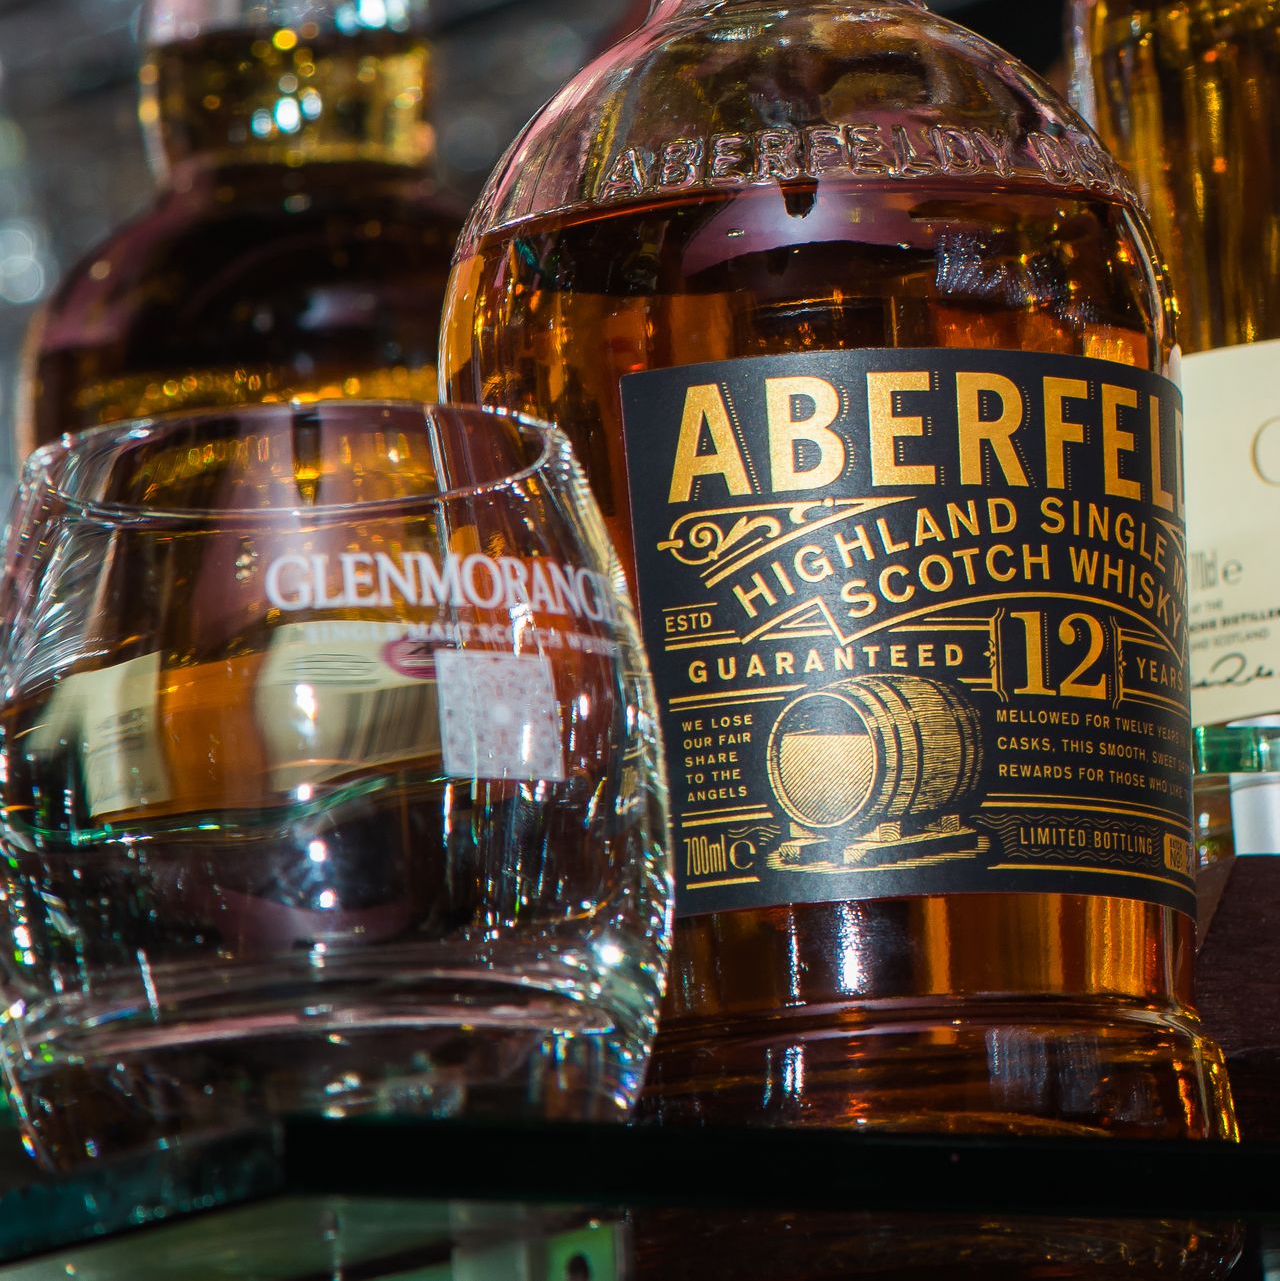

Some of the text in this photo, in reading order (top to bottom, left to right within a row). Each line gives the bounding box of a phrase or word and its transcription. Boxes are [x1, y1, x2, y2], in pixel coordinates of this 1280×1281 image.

[600, 123, 1011, 199] ABERFELDY
[732, 496, 1168, 619] HIGHLAND SINGLE
[263, 551, 621, 624] GLENMORANG
[843, 544, 1051, 619] SCOTCH
[1068, 545, 1182, 638] WHISKY
[665, 611, 712, 633] ESTD
[688, 643, 965, 684] GUARANTEED
[1009, 610, 1107, 700] 12
[1136, 656, 1184, 693] YEARS
[682, 714, 754, 732] WE LOSE
[996, 709, 1080, 725] MELLOWED
[1085, 714, 1110, 729] FOR
[1114, 716, 1154, 736] TWELVE
[683, 732, 752, 750] OUR FAIR
[997, 736, 1056, 754] CASKS,
[1061, 739, 1094, 755] THIS
[1099, 741, 1149, 764] SMOOTH,
[1152, 750, 1177, 769] SWEET
[684, 751, 739, 767] SHARE
[685, 769, 742, 786] TO THE
[998, 764, 1073, 780] REWARDS
[1078, 767, 1104, 783] FOR
[1109, 770, 1146, 789] THOSE
[1149, 776, 1168, 794] WHO
[687, 785, 748, 803] ANGELS
[683, 833, 728, 877] 700ml
[1019, 826, 1087, 848] LIMITED
[1093, 829, 1153, 856] BOTTLING
